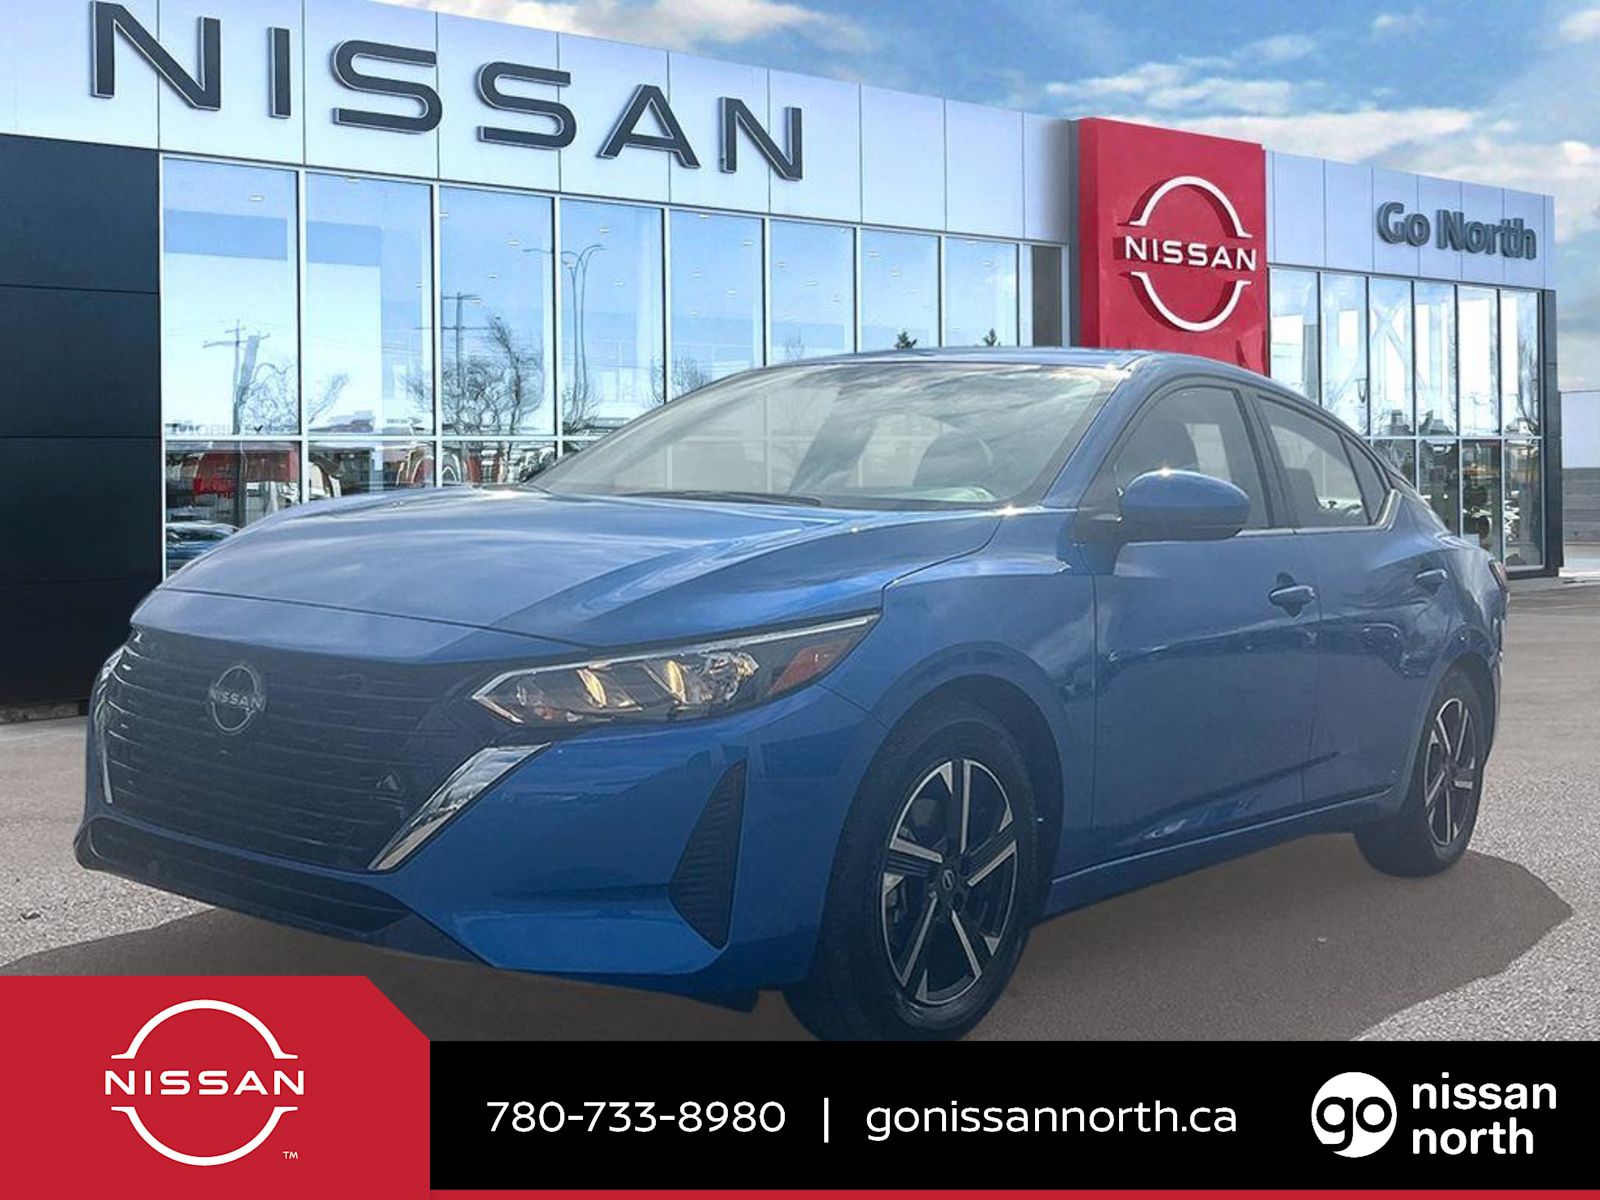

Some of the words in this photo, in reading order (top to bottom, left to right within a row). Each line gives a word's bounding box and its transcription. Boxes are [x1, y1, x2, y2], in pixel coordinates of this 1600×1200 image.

[90, 1, 803, 181] NISSAN
[1125, 235, 1257, 272] NISSAN
[1377, 201, 1431, 247] Go
[1435, 209, 1537, 260] North
